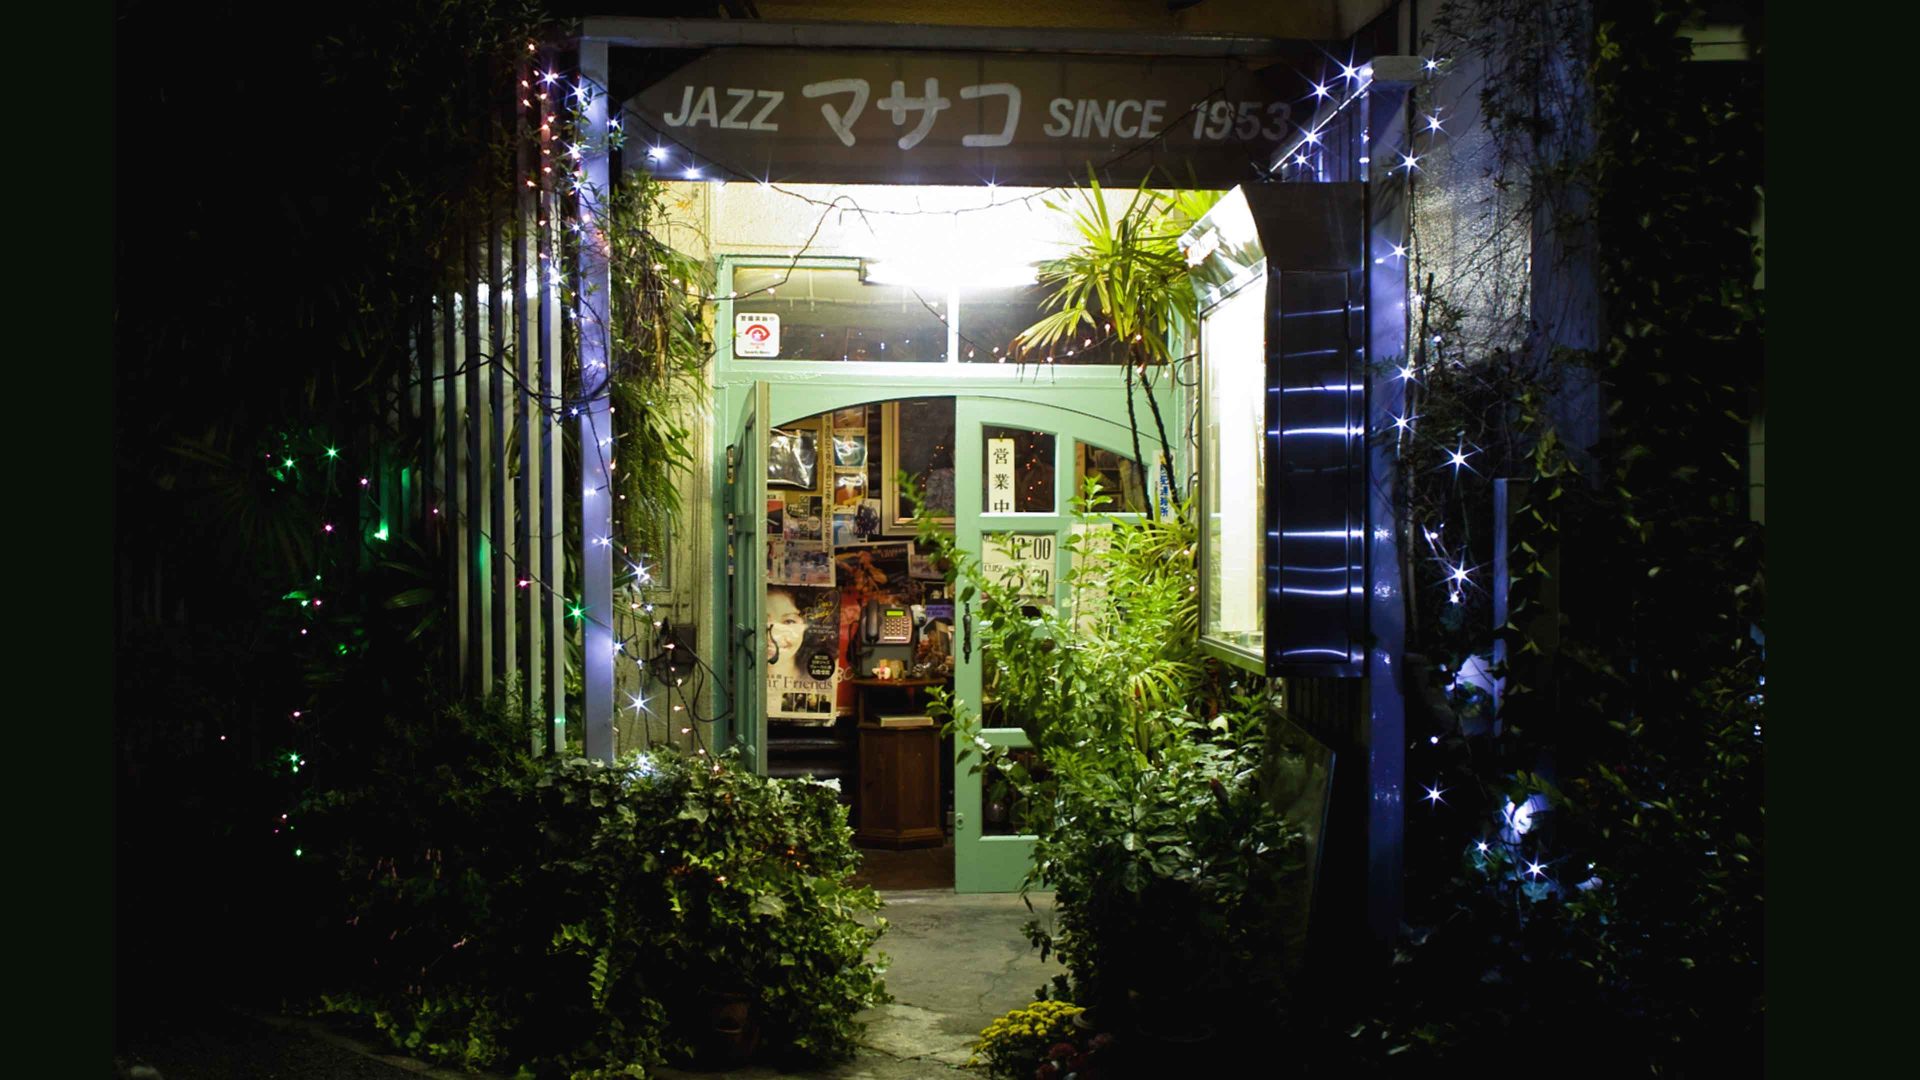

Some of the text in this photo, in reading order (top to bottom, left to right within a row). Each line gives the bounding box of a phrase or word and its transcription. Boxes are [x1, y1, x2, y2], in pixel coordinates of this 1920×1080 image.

[663, 77, 1292, 150] JAZZ マサコ SINCE 1953
[993, 448, 1009, 512] 営業中
[1010, 537, 1051, 560] 12:00
[783, 676, 833, 690] Friends
